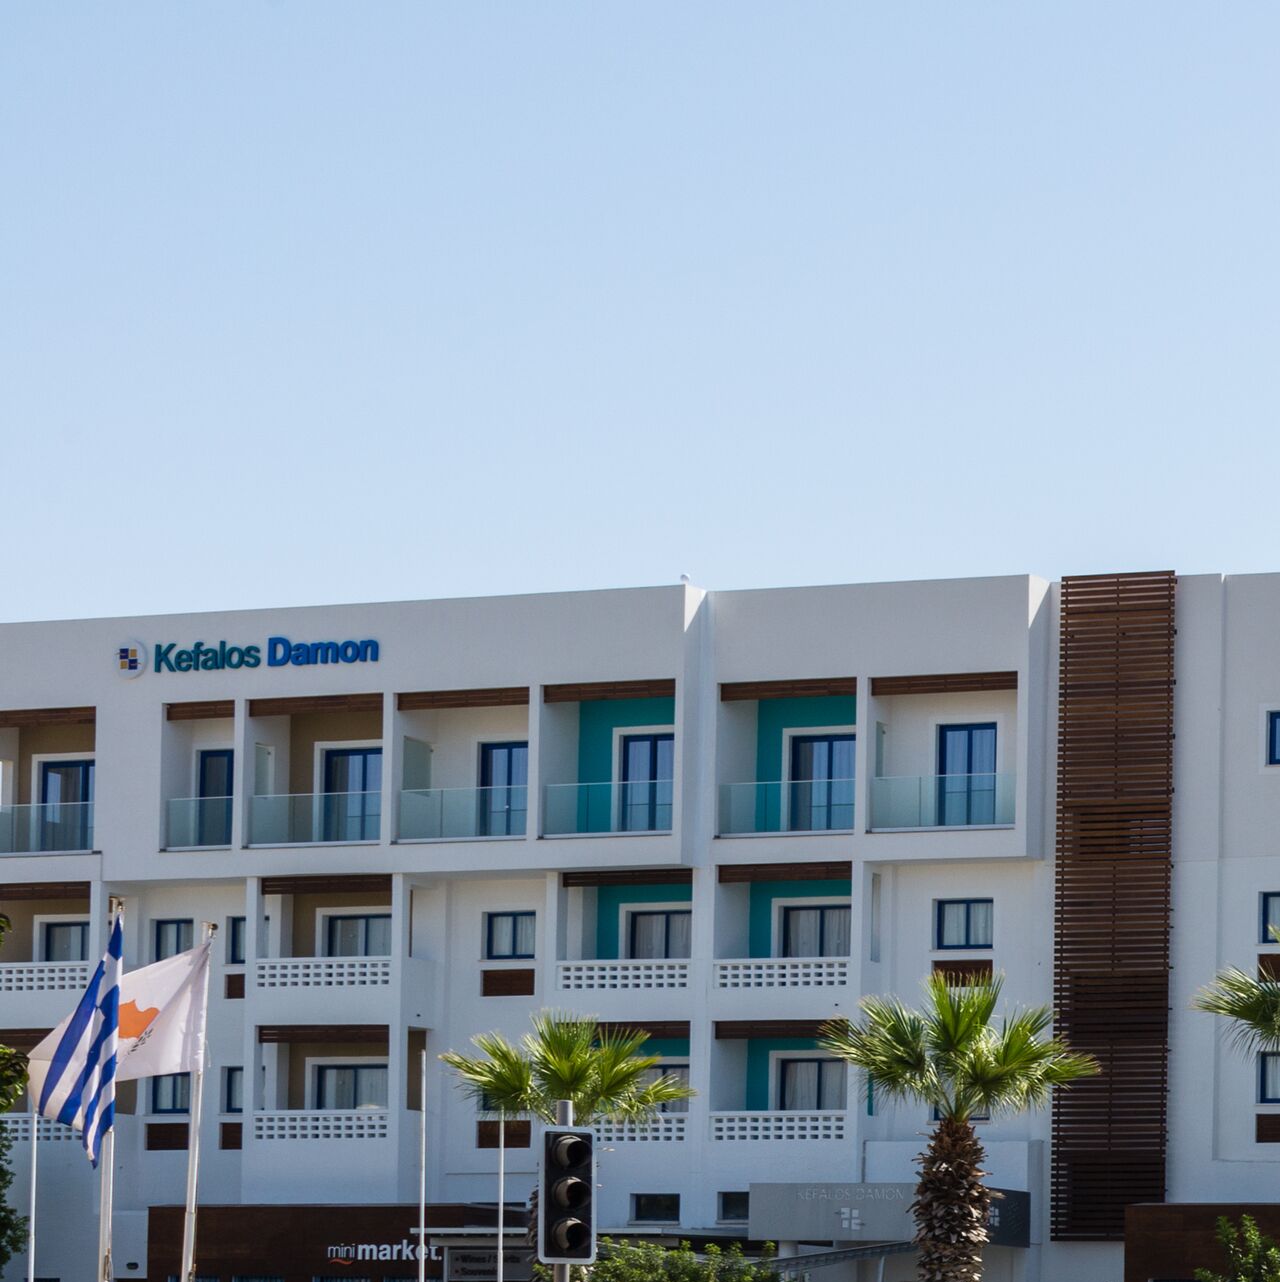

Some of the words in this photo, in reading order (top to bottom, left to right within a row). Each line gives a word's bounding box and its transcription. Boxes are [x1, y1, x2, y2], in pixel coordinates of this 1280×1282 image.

[154, 641, 261, 673] Kefalos
[267, 637, 379, 667] Damon
[855, 1187, 905, 1201] DAMON
[327, 1243, 355, 1258] mini
